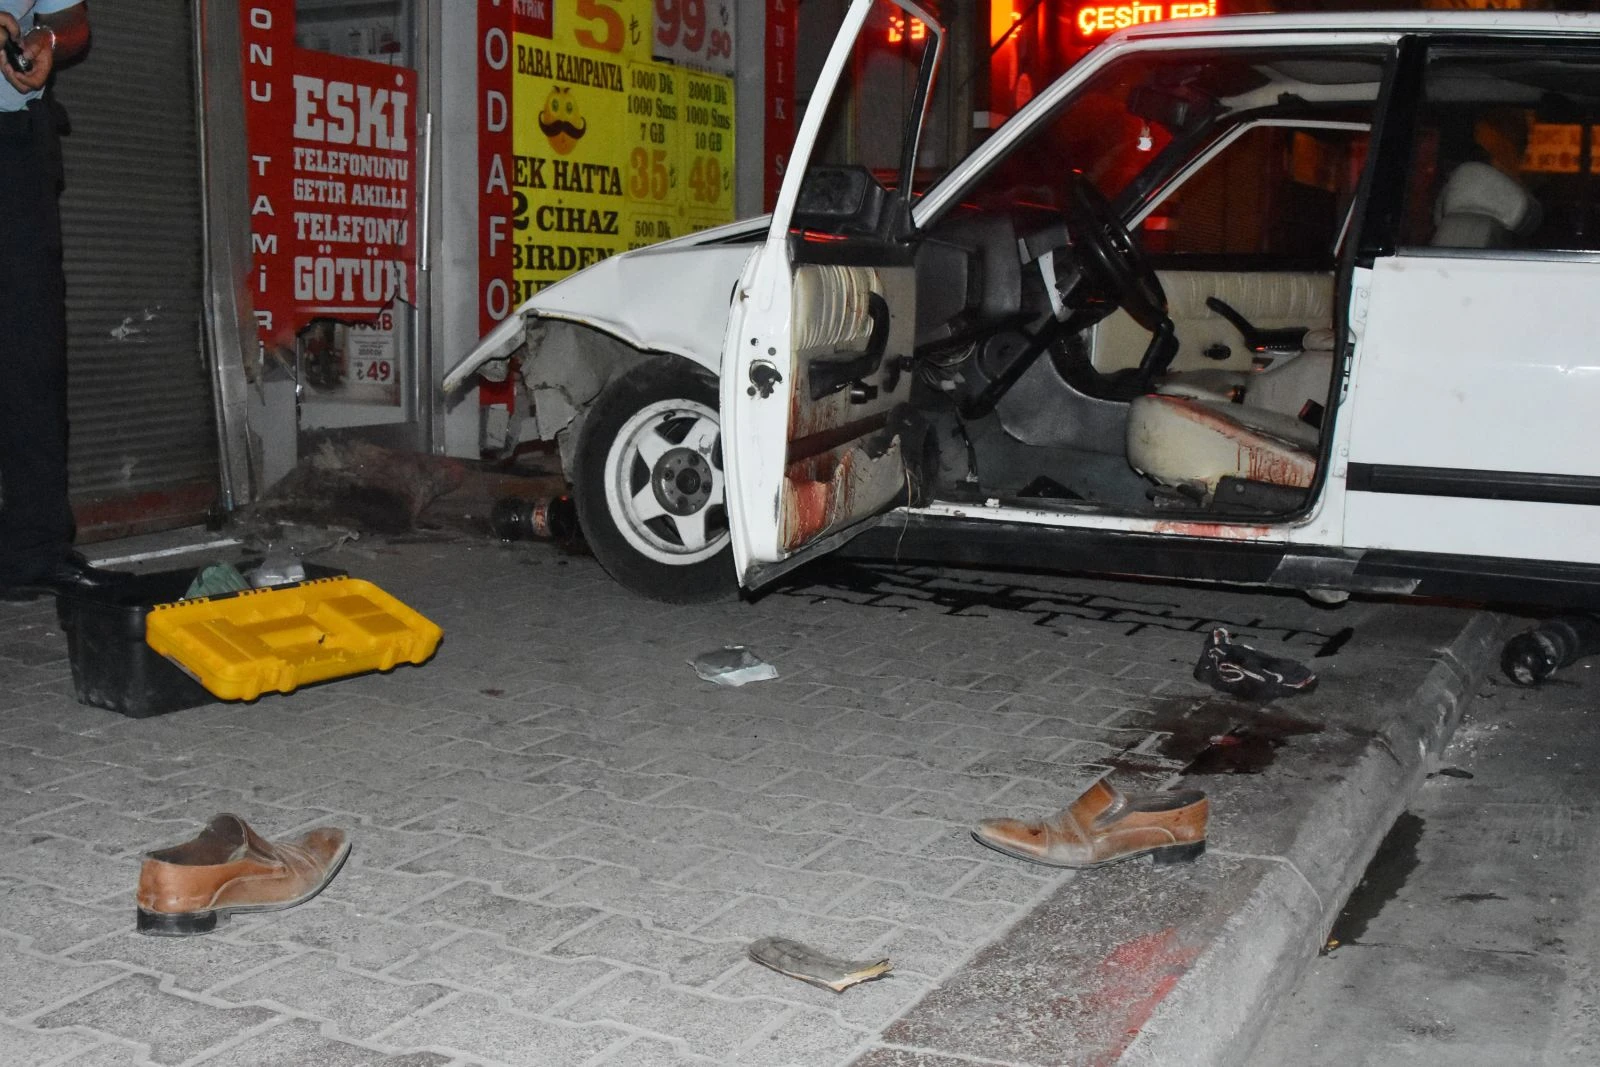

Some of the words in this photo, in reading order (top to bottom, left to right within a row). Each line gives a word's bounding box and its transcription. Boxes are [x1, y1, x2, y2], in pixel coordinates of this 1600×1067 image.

[517, 44, 553, 80] BABA
[556, 53, 624, 92] KAMPANYA
[631, 70, 656, 92] 1000
[659, 73, 673, 95] Dk
[293, 73, 408, 151] ESKİ
[627, 95, 653, 117] 1000
[656, 98, 677, 121] Sms
[686, 105, 709, 126] 1000
[640, 122, 647, 141] 7
[650, 123, 665, 144] GB
[709, 132, 722, 152] GB
[293, 147, 408, 180] TELEFONUNU
[553, 160, 623, 196] HATTA
[630, 147, 669, 201] 35
[688, 156, 721, 204] 49
[293, 175, 347, 204] GETİR
[351, 183, 408, 209] AKILLI
[293, 211, 409, 246] TELEFONU
[536, 198, 619, 235] CİHAZ
[294, 245, 409, 302] GÖTÜR
[367, 360, 391, 381] 49
